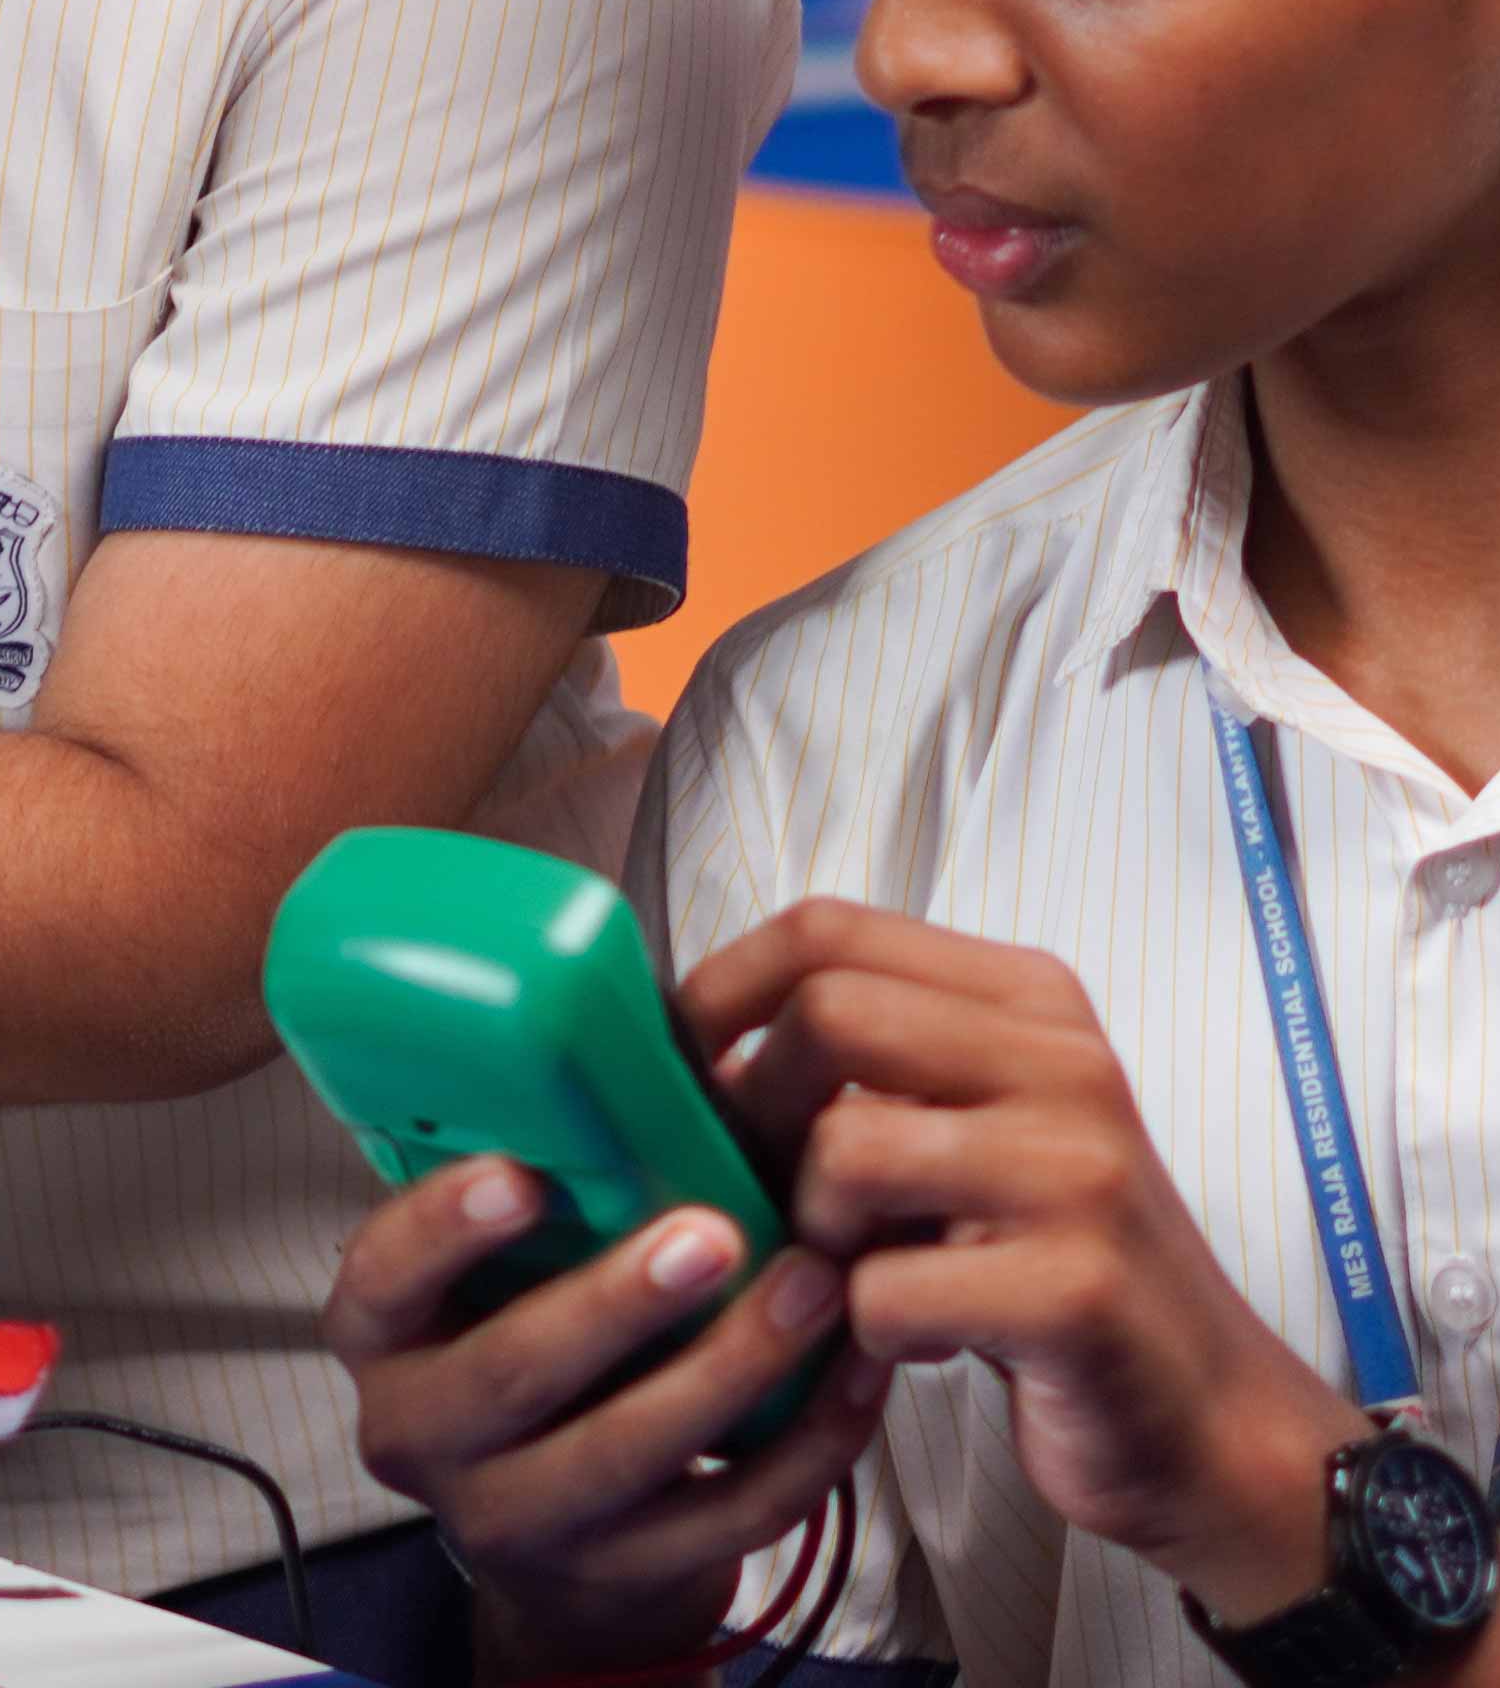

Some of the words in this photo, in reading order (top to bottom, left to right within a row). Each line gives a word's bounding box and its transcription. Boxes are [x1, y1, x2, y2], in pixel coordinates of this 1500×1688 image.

[1256, 864, 1296, 977] SCHOOL
[1281, 981, 1338, 1160] RESIDENTIAL
[1321, 1162, 1357, 1237] RAJA
[1340, 1240, 1374, 1301] MES
